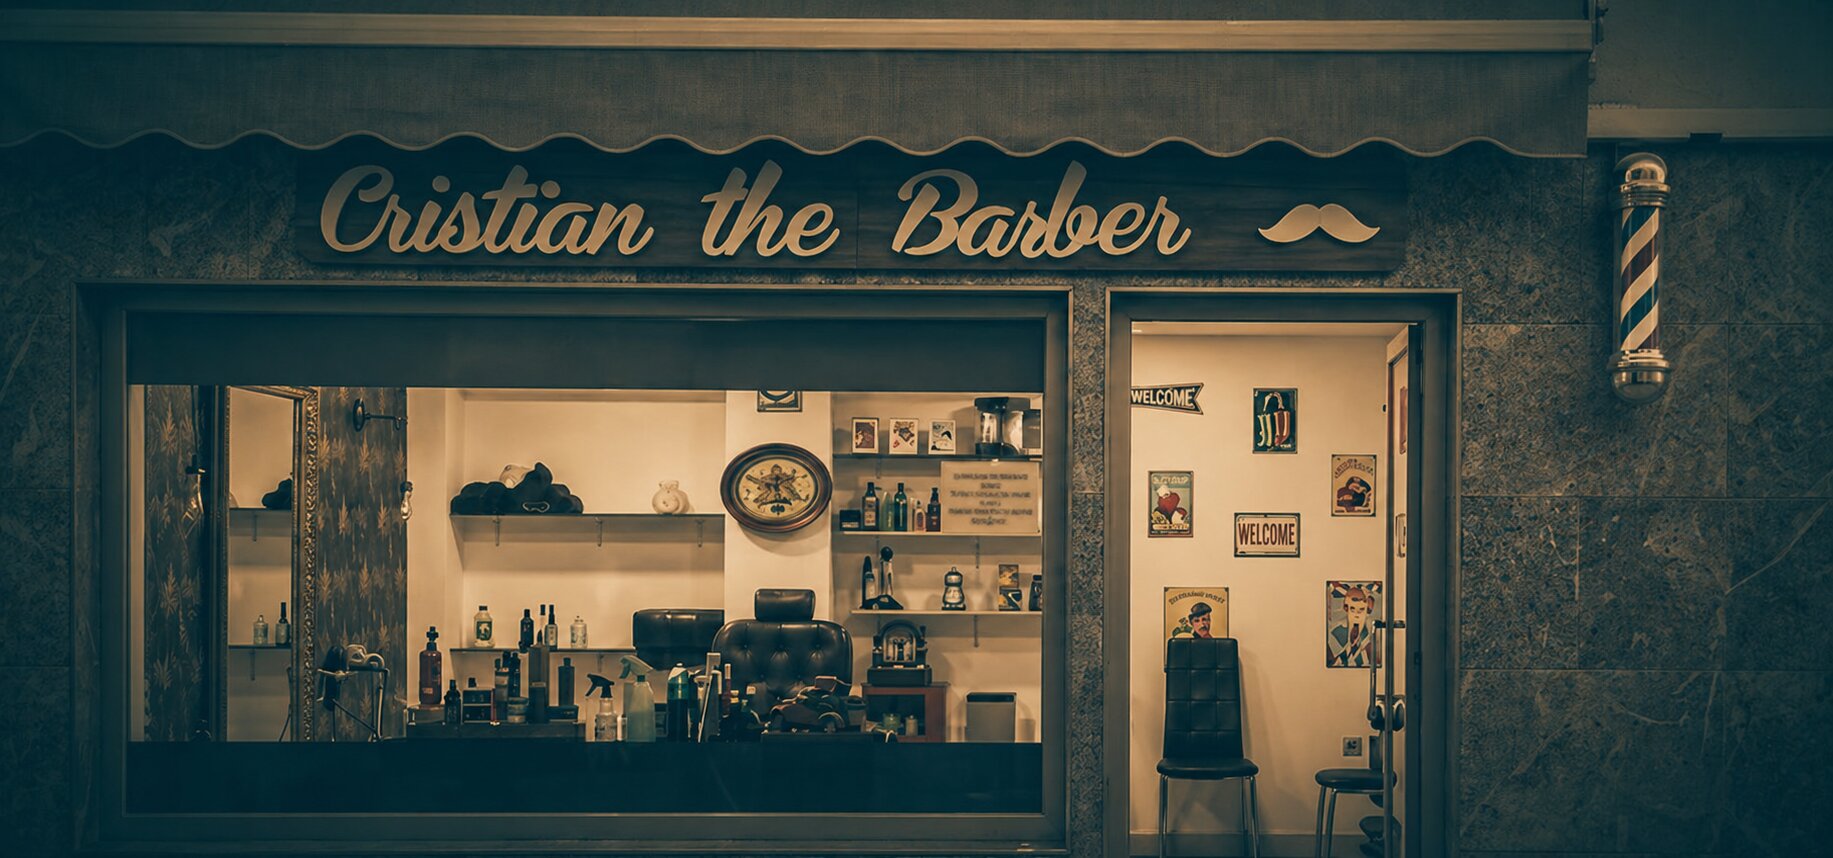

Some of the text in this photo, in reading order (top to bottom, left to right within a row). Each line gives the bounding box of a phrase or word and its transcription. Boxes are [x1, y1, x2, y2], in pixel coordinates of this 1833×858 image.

[320, 159, 1192, 259] Cristian the Barber
[1130, 388, 1196, 409] WELCOME
[1238, 523, 1295, 546] WELCOME
